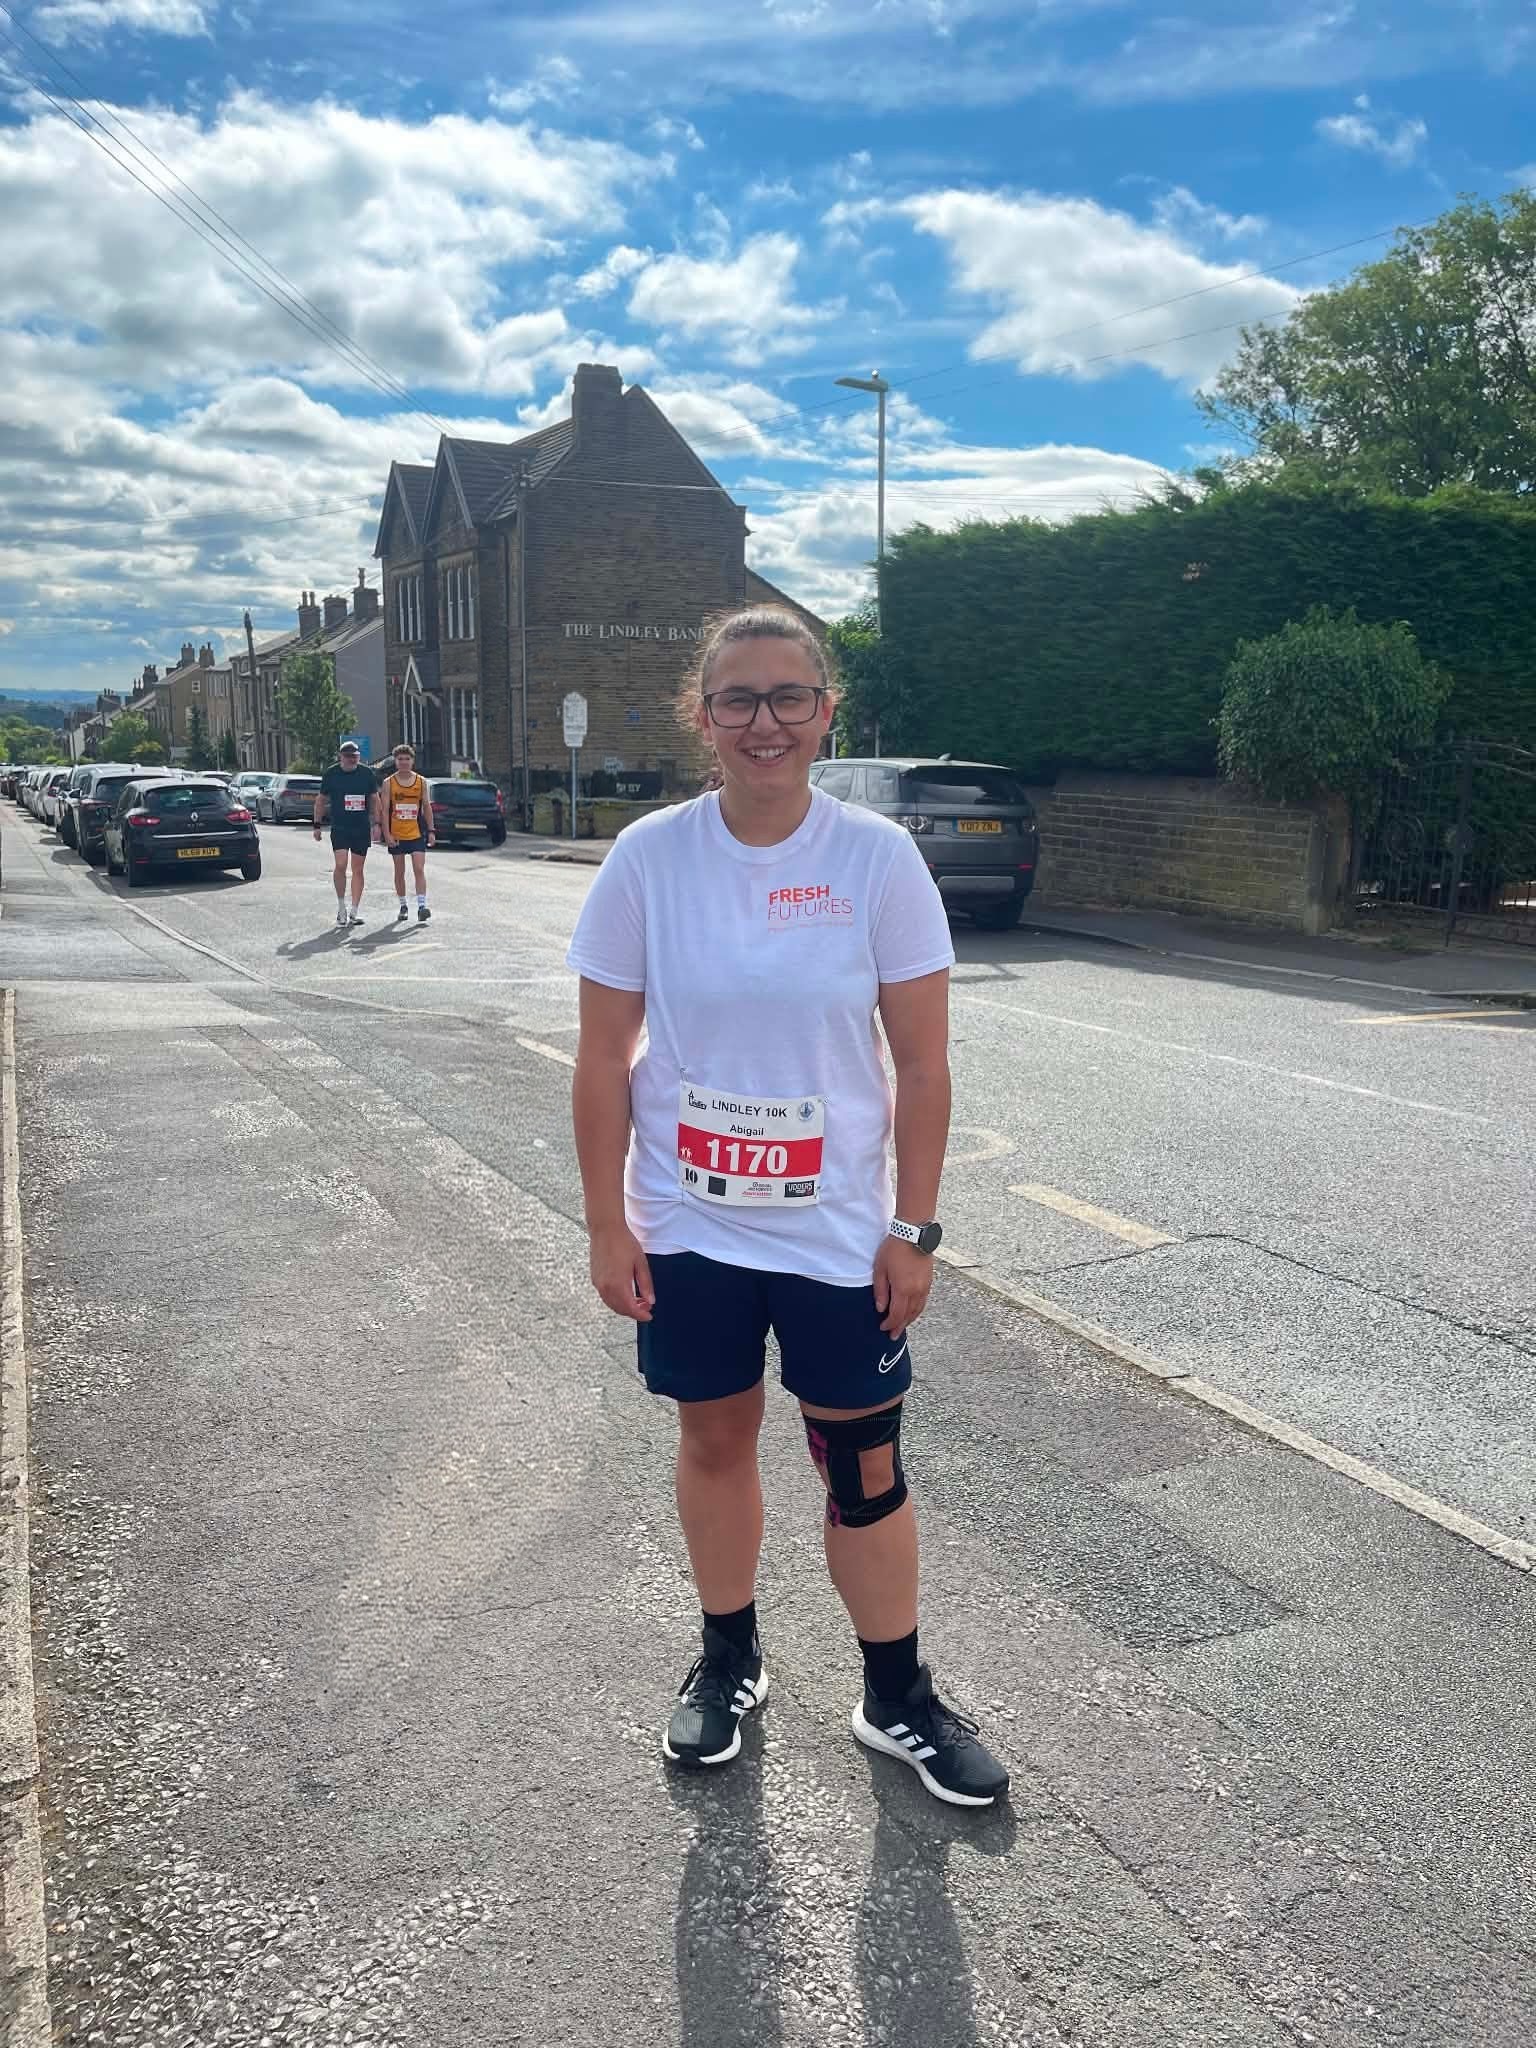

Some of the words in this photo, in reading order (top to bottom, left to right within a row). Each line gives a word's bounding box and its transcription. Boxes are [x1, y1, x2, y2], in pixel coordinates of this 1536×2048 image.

[562, 623, 592, 637] THE
[599, 624, 660, 639] LINDLEY
[769, 884, 830, 905] FRESH
[768, 898, 853, 920] FUTURES
[712, 1100, 761, 1117] LINDLEY
[766, 1107, 787, 1118] 10K
[730, 1124, 764, 1136] Abigail
[707, 1138, 788, 1175] 1170
